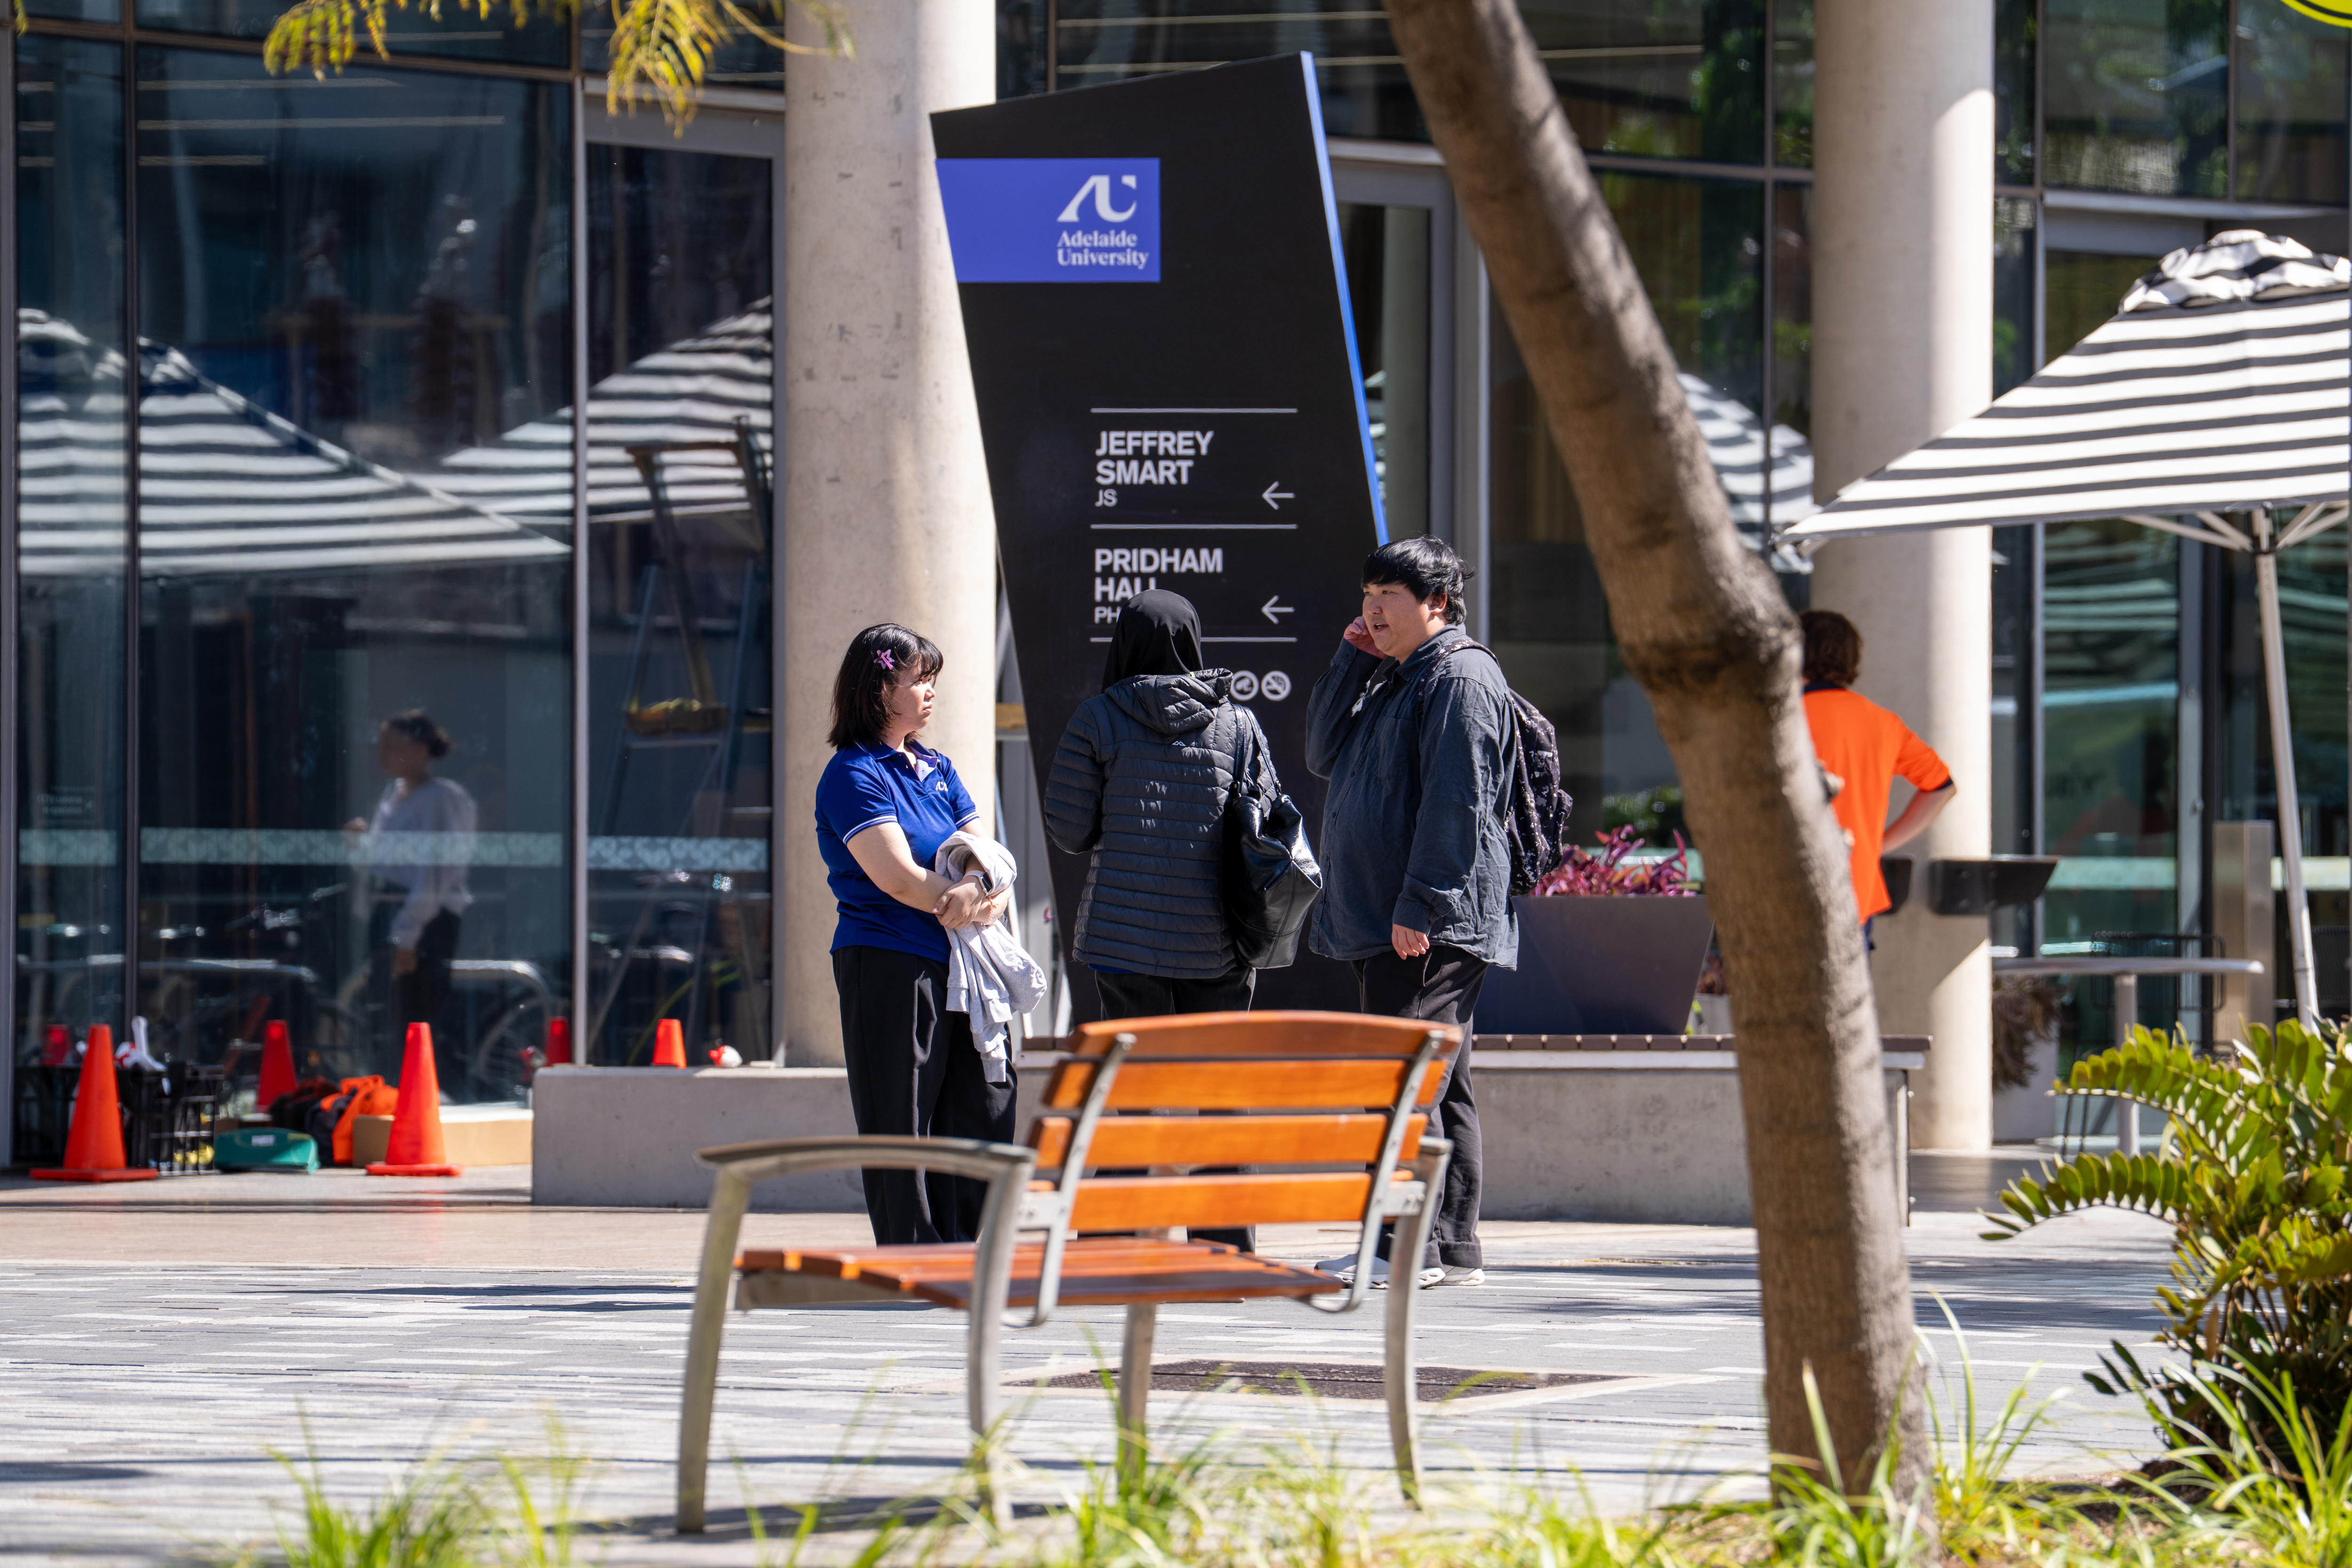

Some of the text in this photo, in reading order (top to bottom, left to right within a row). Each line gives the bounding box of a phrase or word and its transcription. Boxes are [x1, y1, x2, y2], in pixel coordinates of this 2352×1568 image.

[1057, 229, 1138, 247] Adelaide
[1057, 248, 1149, 270] University
[1095, 430, 1214, 456] JEFFREY
[1095, 459, 1194, 485] SMART
[1095, 489, 1118, 507] JS
[1095, 548, 1223, 573] PRIDHAM
[1094, 606, 1121, 624] PH
